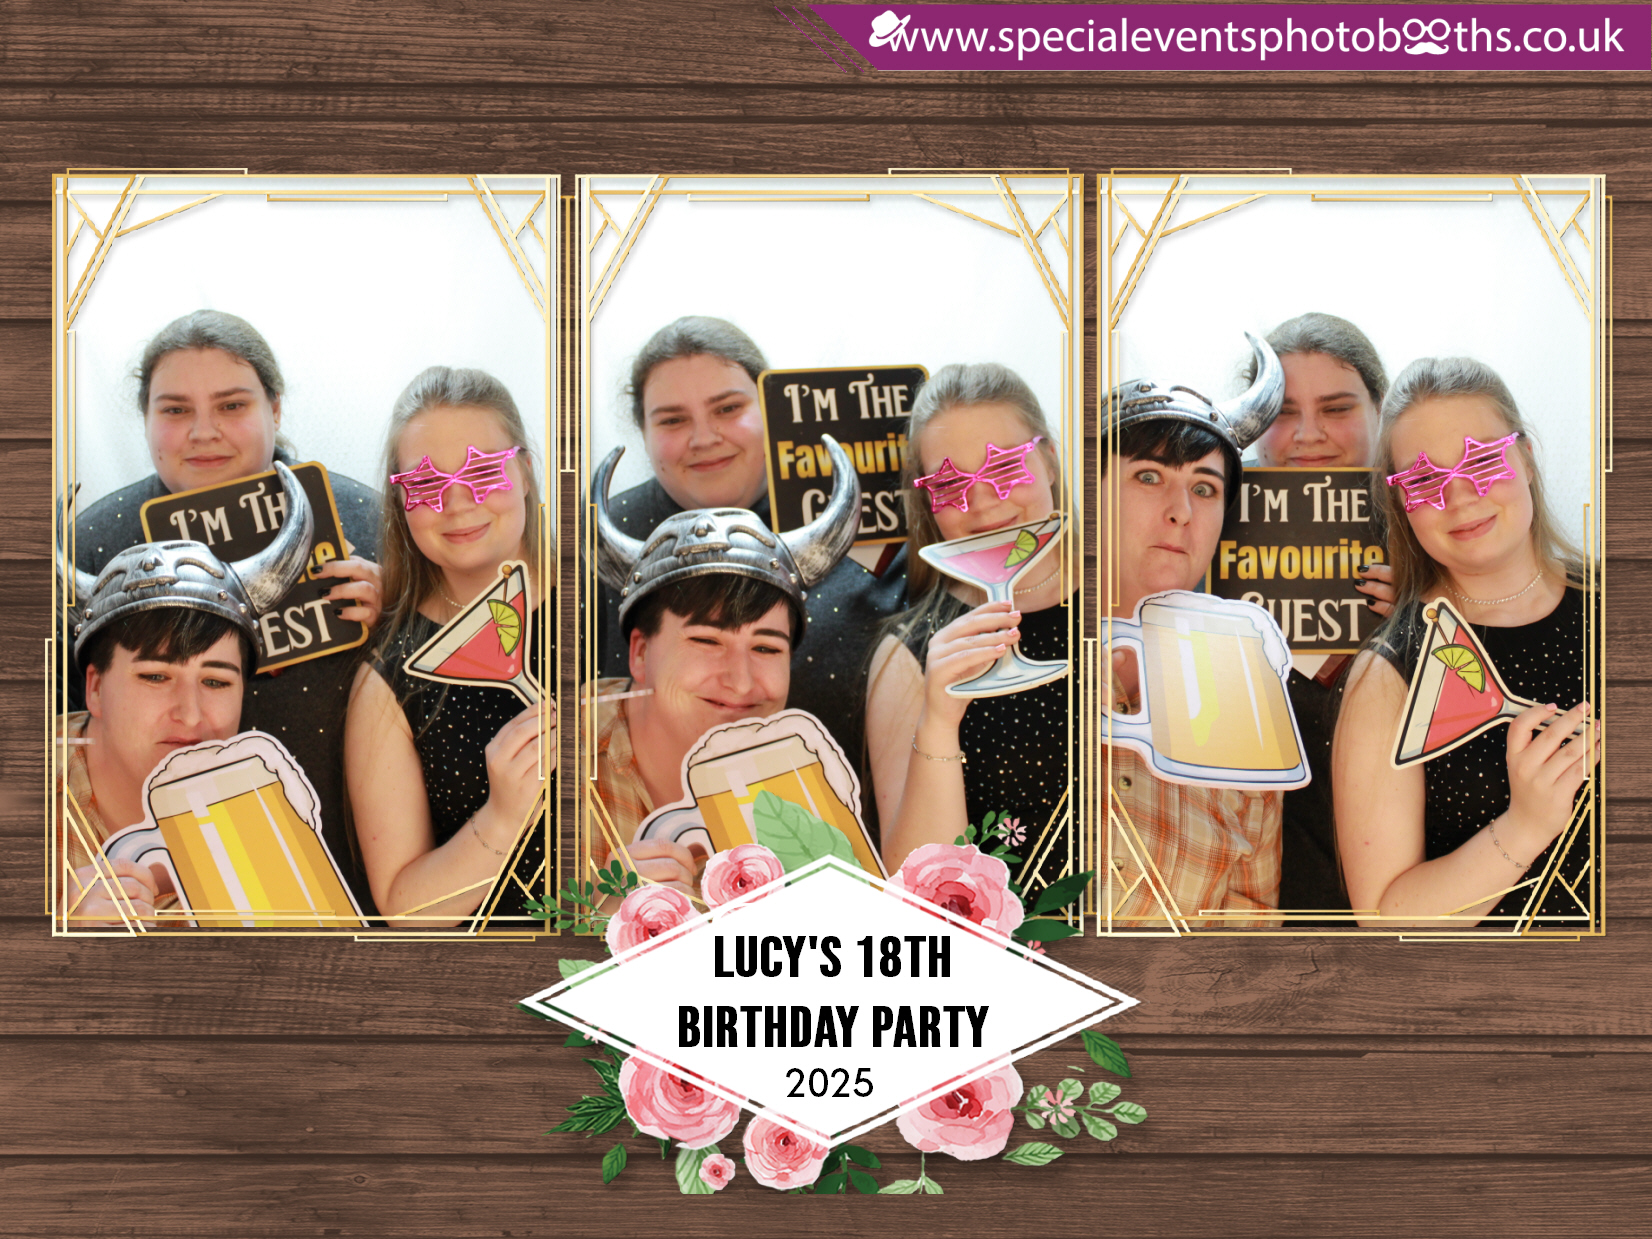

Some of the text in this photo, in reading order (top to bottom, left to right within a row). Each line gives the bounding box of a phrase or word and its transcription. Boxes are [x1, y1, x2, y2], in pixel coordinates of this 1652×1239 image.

[784, 373, 912, 424] I'M THE
[169, 482, 287, 547] I'M TH
[1239, 475, 1371, 523] I'M THE
[259, 599, 332, 658] EST
